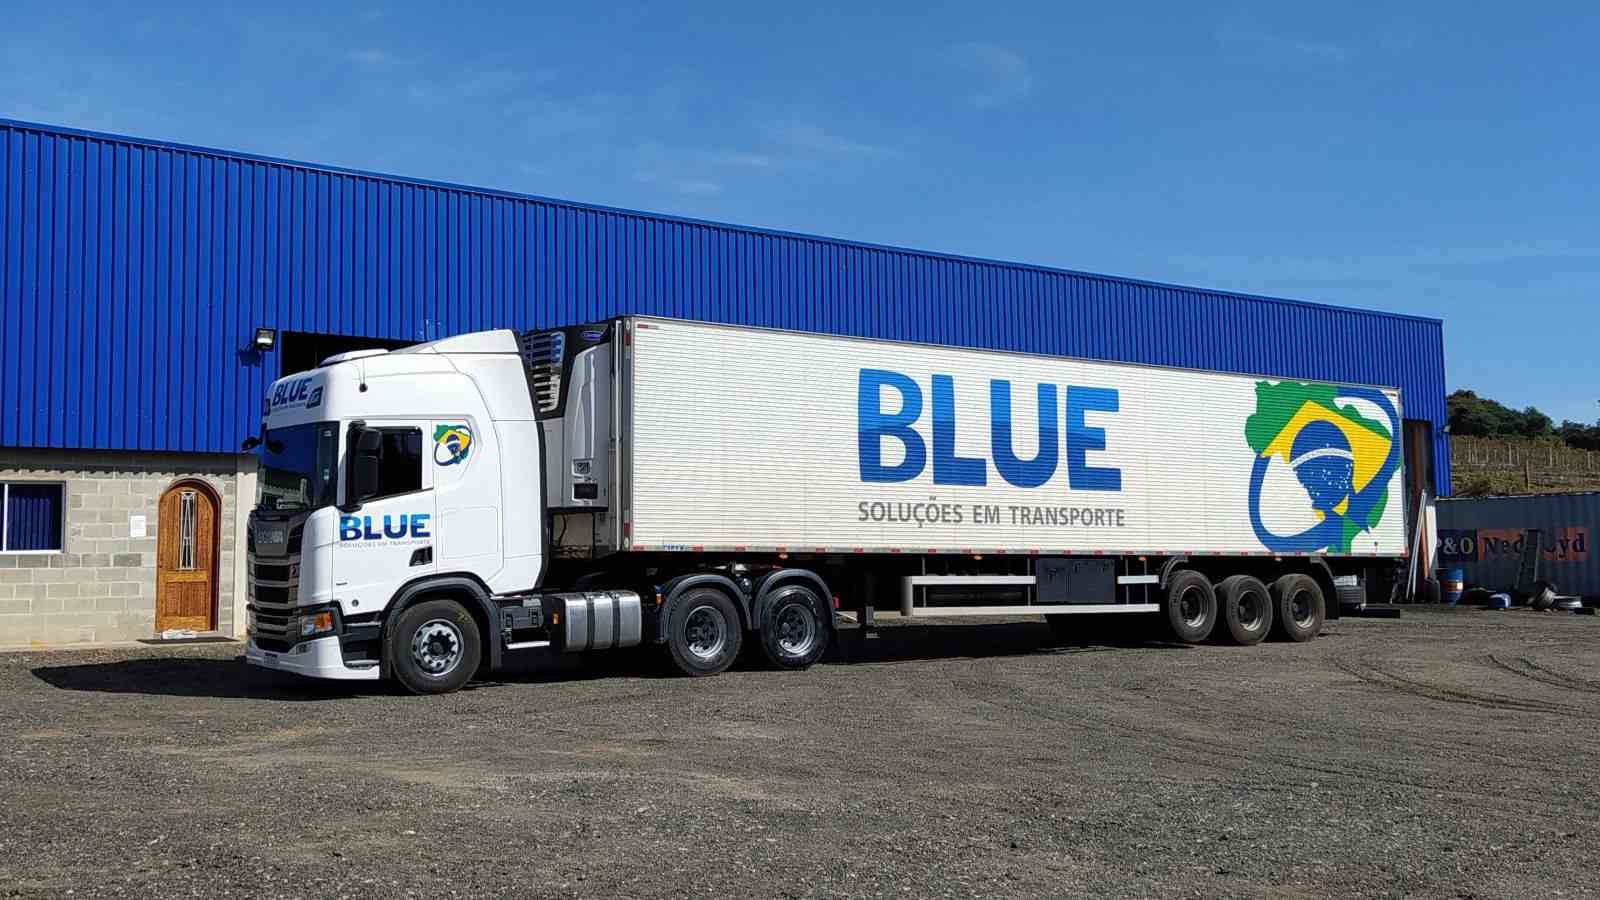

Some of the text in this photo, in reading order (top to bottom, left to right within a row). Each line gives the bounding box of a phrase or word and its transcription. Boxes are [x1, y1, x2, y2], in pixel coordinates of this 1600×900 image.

[272, 377, 313, 407] BLUE
[858, 367, 1122, 491] BLUE
[339, 513, 431, 541] BLUE
[858, 495, 1125, 528] SOLUÇÕES EM TRANSPORTE
